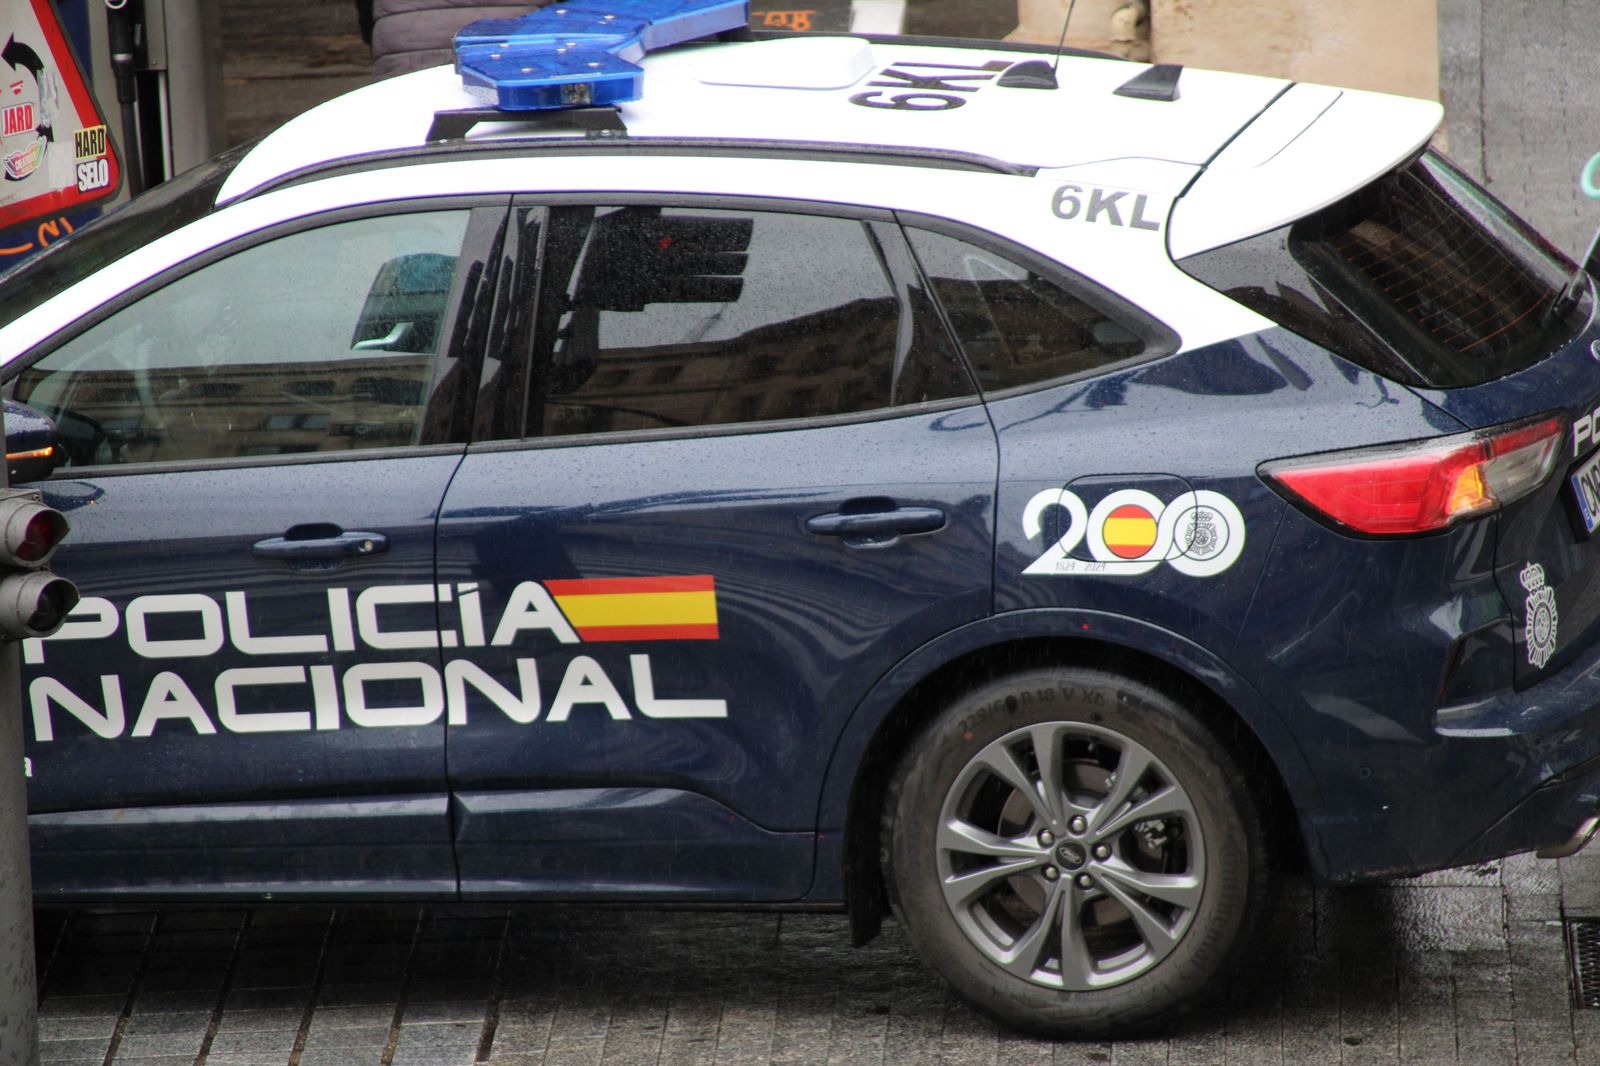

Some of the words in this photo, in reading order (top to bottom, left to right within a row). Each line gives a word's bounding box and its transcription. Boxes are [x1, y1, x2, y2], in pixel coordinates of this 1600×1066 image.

[4, 104, 33, 135] JARD
[75, 127, 105, 158] HARD
[78, 158, 109, 192] SELO
[1051, 184, 1160, 232] 6KL
[1022, 487, 1246, 577] 200
[29, 654, 728, 741] NACIONAL
